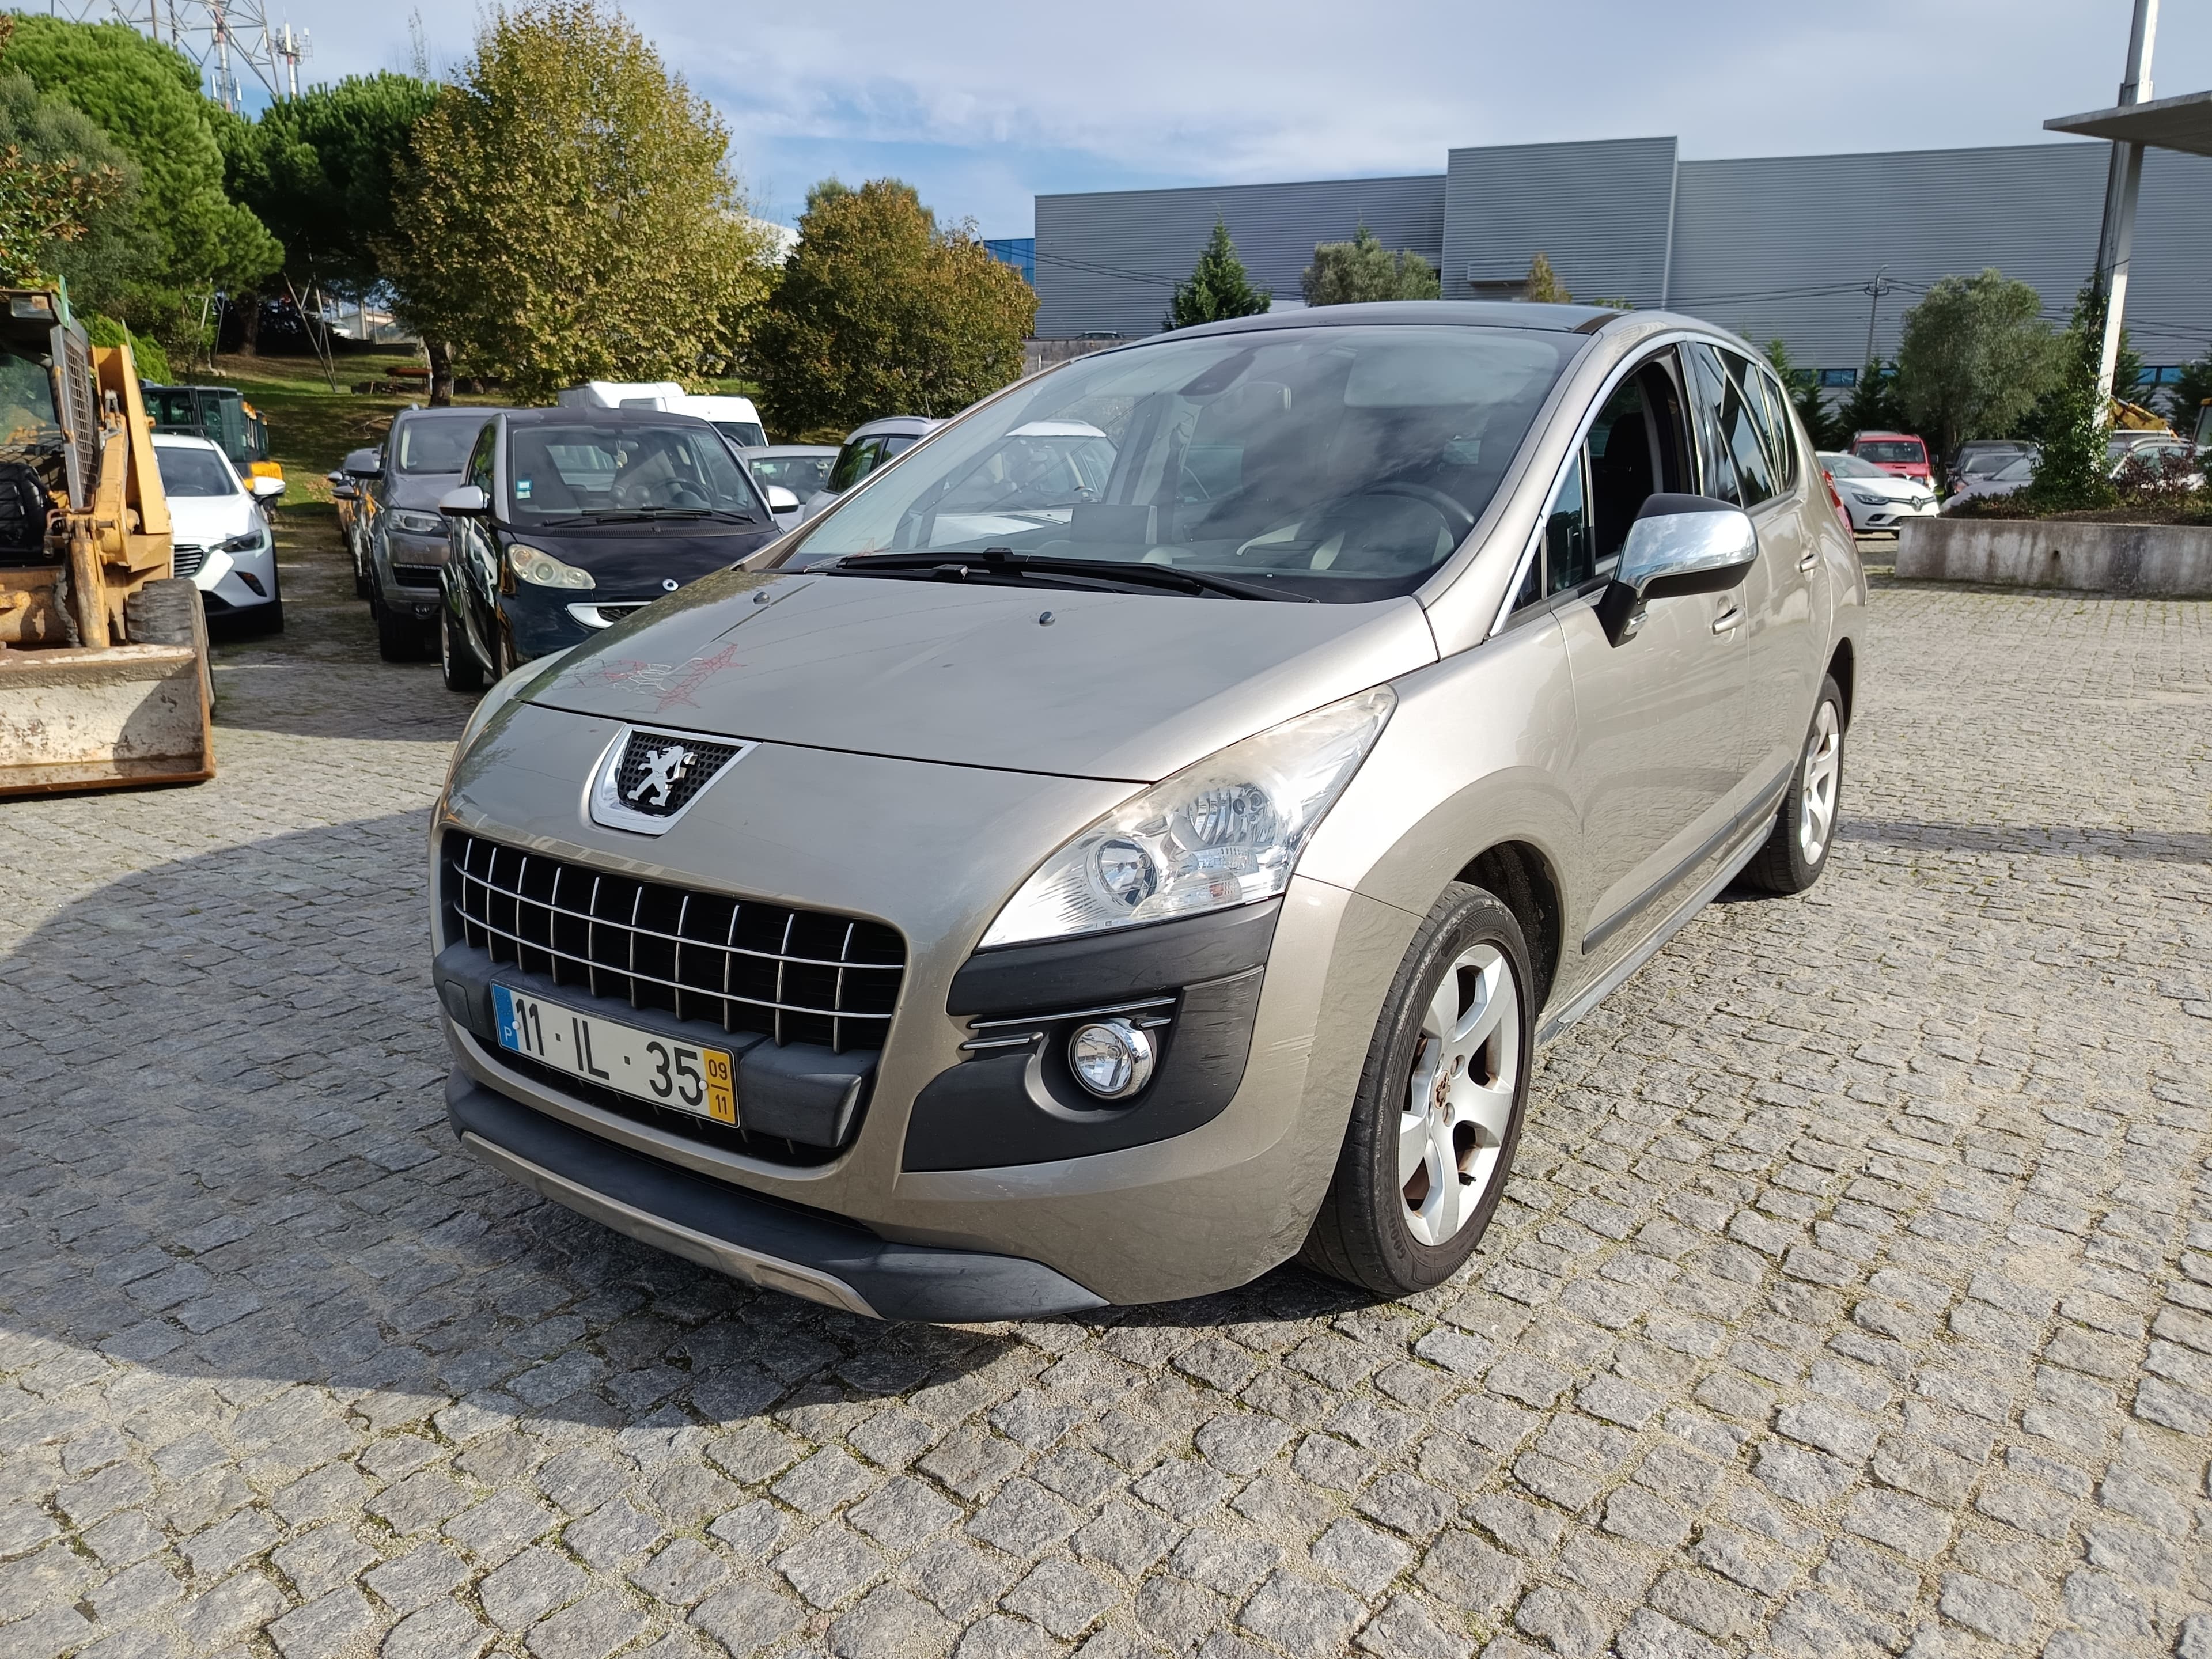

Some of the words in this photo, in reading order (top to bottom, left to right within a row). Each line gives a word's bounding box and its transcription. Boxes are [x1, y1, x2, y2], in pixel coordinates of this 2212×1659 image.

[503, 1025, 512, 1041] P
[708, 1059, 728, 1081] 09
[715, 1094, 728, 1115] 11
